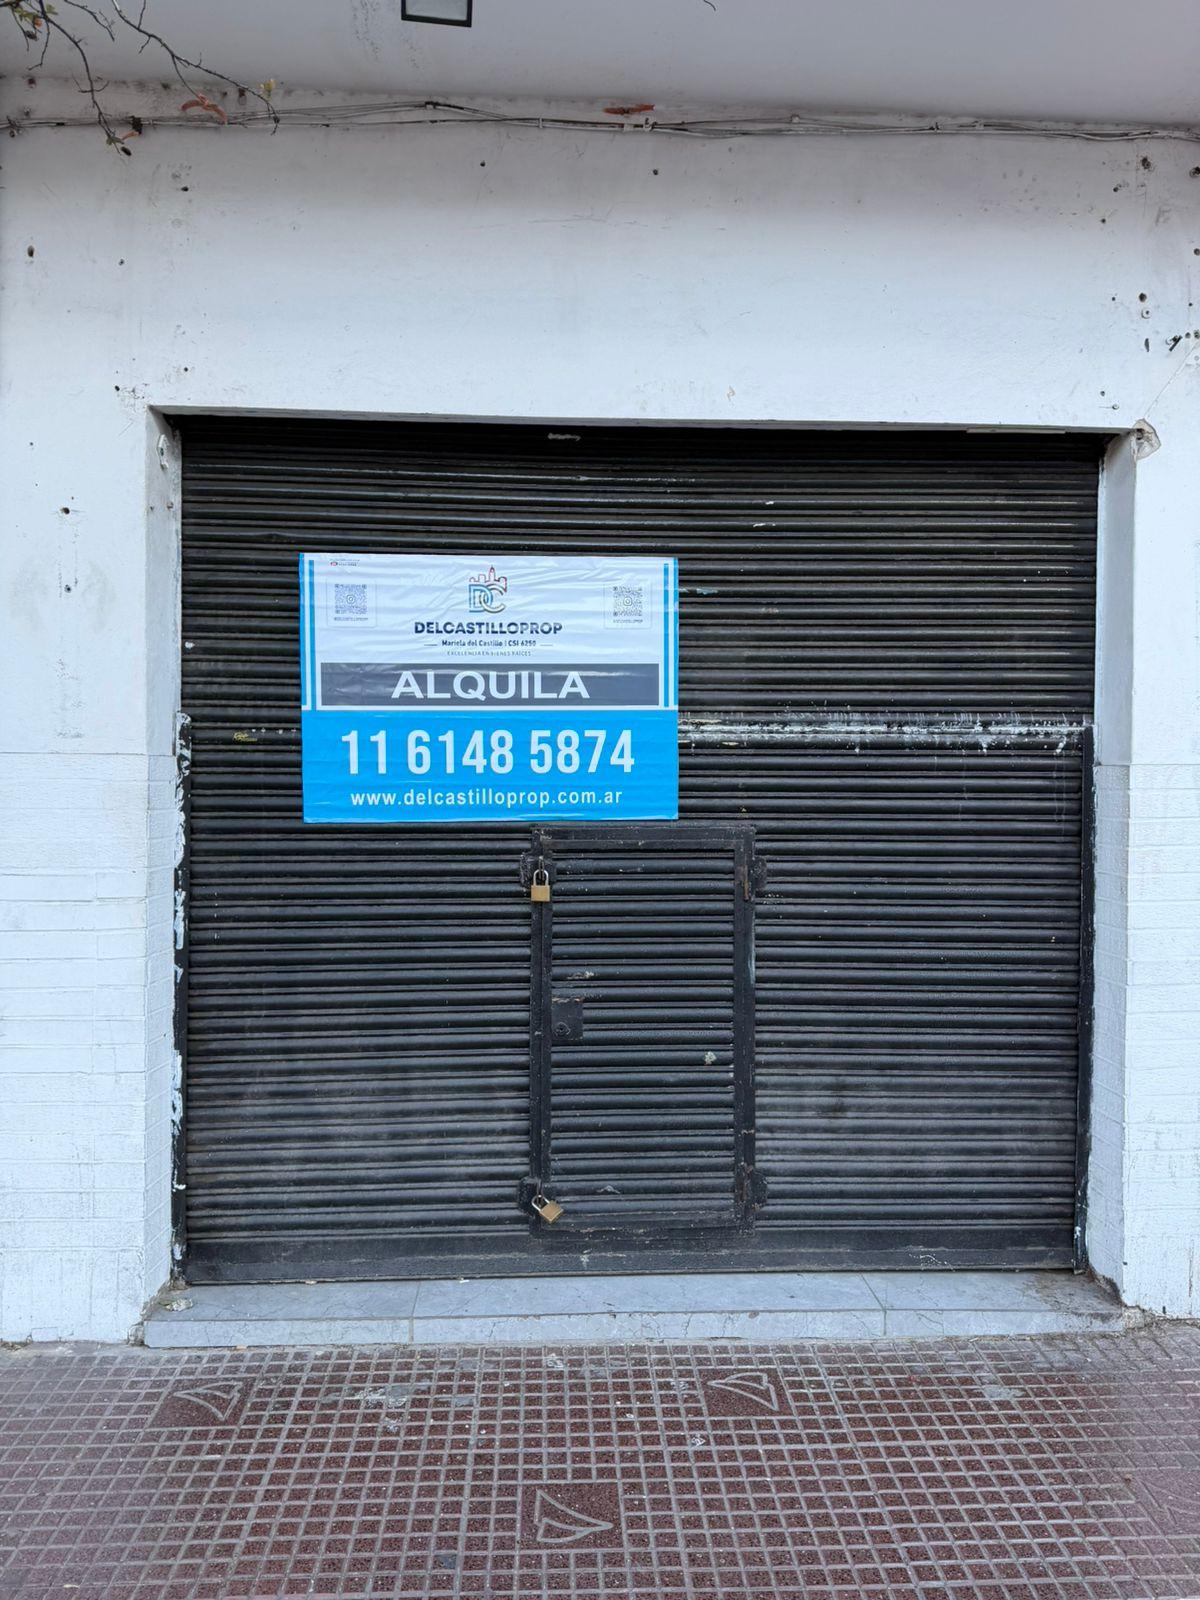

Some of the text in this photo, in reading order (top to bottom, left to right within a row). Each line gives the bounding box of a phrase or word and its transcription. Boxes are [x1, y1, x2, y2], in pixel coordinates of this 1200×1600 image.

[414, 621, 563, 635] DELCASTILLOPROP
[441, 639, 466, 647] Mariela
[467, 639, 478, 647] del
[479, 639, 503, 647] Castillo
[508, 639, 519, 647] CSI
[520, 639, 537, 647] 6250
[391, 670, 590, 701] ALQUILA
[341, 729, 635, 775] 11 6148 5874
[350, 788, 623, 809] www.delcastilloprop.com.ar
